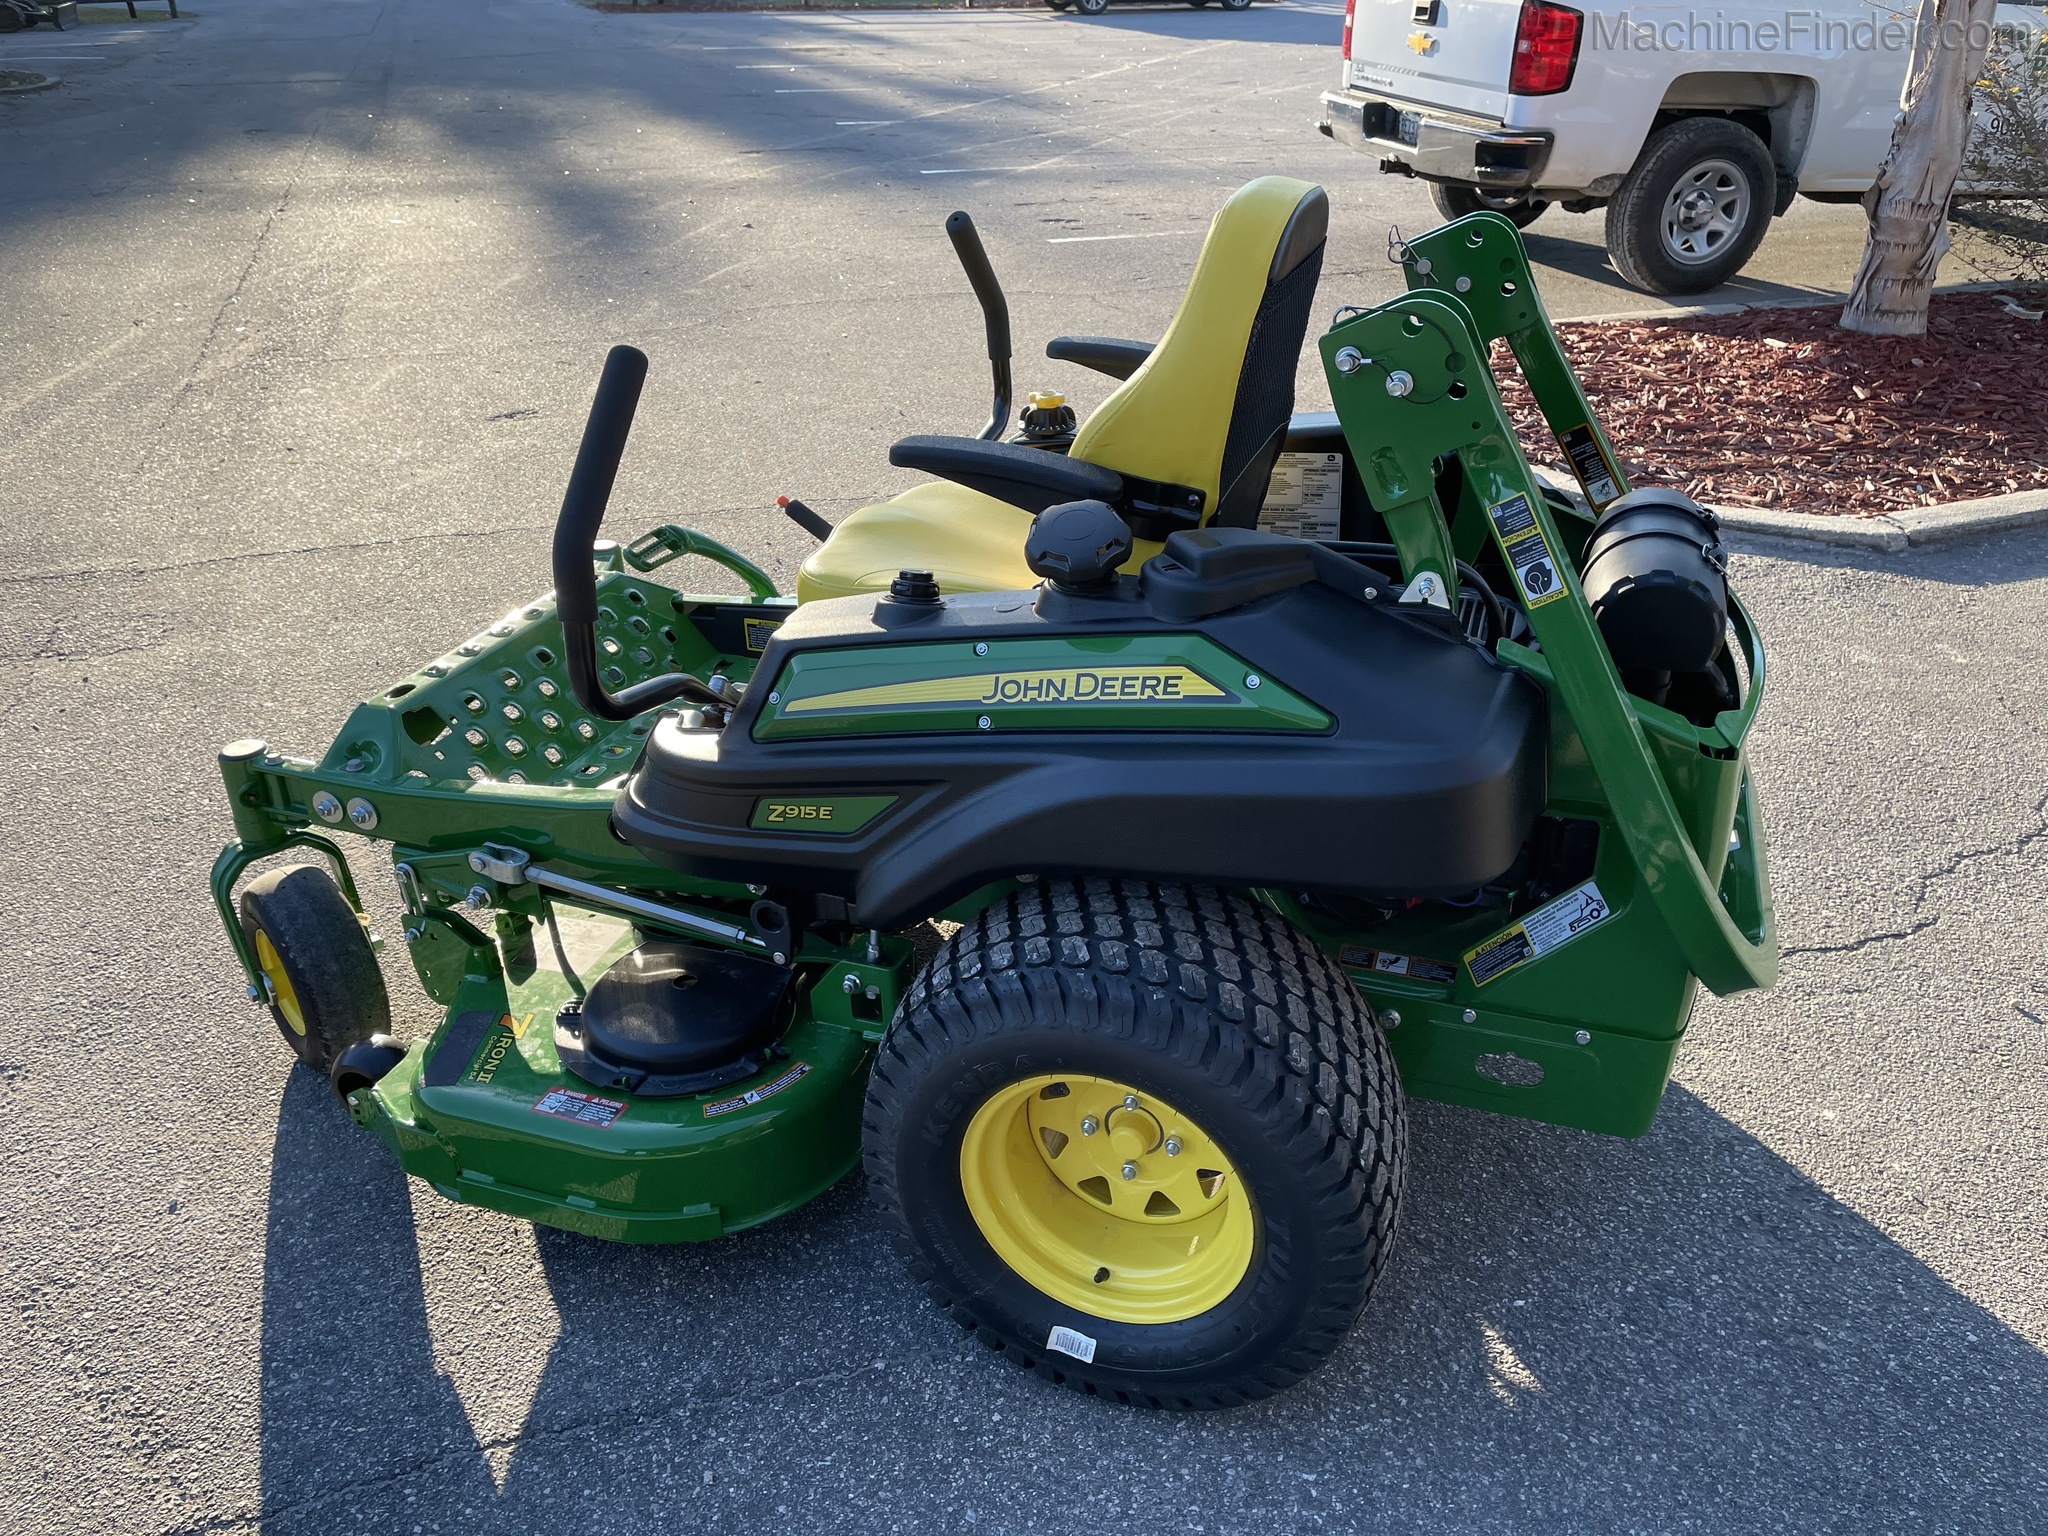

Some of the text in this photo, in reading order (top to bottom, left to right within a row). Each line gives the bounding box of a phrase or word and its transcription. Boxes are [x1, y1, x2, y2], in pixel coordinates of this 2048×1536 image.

[1502, 527, 1533, 545] ATENCIÓN
[1531, 592, 1560, 607] CAUTION
[981, 672, 1184, 702] JOHN DEERE
[1481, 931, 1513, 953] ATENCIÓN
[473, 1035, 498, 1071] Commercial
[483, 1032, 516, 1071] IRON
[565, 1090, 588, 1099] DANGER
[599, 1098, 624, 1109] PELIGRO
